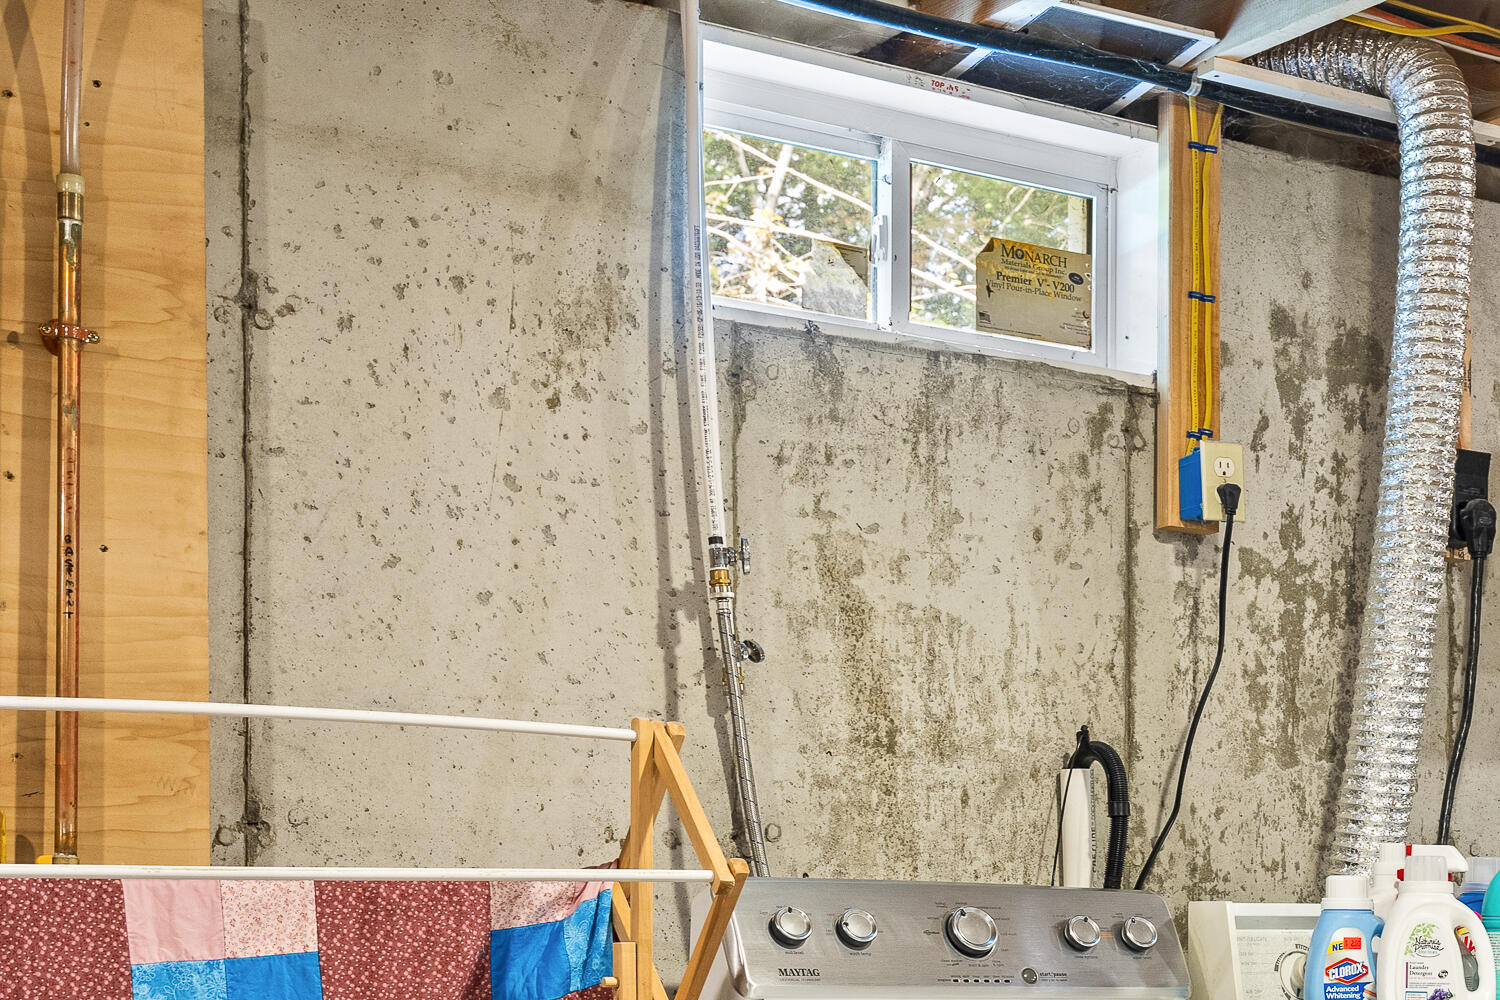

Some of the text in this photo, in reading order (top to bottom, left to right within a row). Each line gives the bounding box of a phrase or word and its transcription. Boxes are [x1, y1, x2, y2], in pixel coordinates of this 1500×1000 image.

[931, 80, 944, 88] TOP
[1001, 243, 1067, 268] MONARCH
[1001, 258, 1031, 269] Materials
[1054, 267, 1067, 275] Inc.
[996, 271, 1032, 286] Premier
[1052, 280, 1075, 293] V200
[985, 279, 1005, 291] Vinyl
[1053, 291, 1082, 301] Window
[1332, 943, 1344, 951] NE
[778, 968, 820, 977] MAYTAG
[1329, 963, 1363, 980] CLOROX
[1326, 985, 1359, 993] Advanced
[1326, 992, 1360, 1000] Whitening
